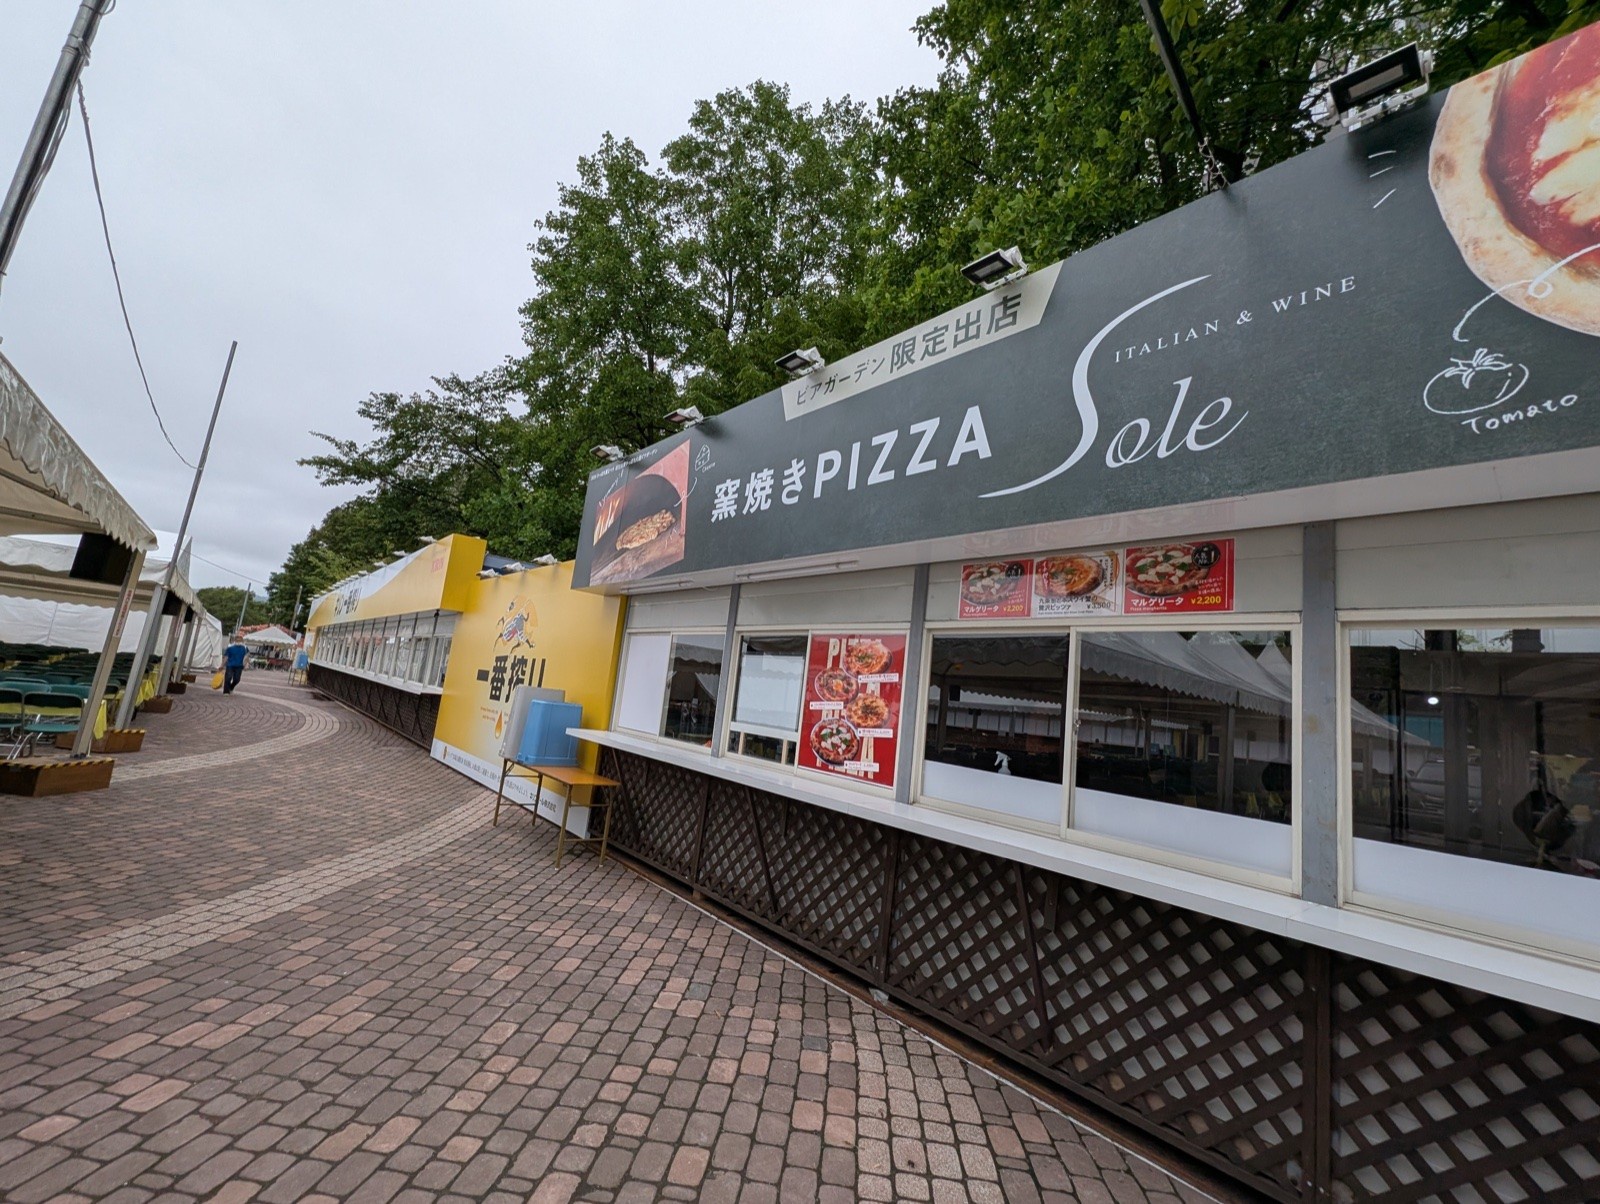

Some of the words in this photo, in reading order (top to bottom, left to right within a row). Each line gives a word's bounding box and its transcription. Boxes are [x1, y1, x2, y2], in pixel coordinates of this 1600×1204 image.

[1114, 319, 1221, 363] ITALIAN
[1235, 309, 1254, 326] &
[1271, 275, 1358, 314] WINE
[794, 292, 1024, 408] ビアガーデン限定出店
[1461, 393, 1580, 436] Tomato
[964, 605, 999, 614] マルゲリータ
[1131, 597, 1184, 607] マルゲリータ
[1191, 596, 1221, 605] ¥2,200
